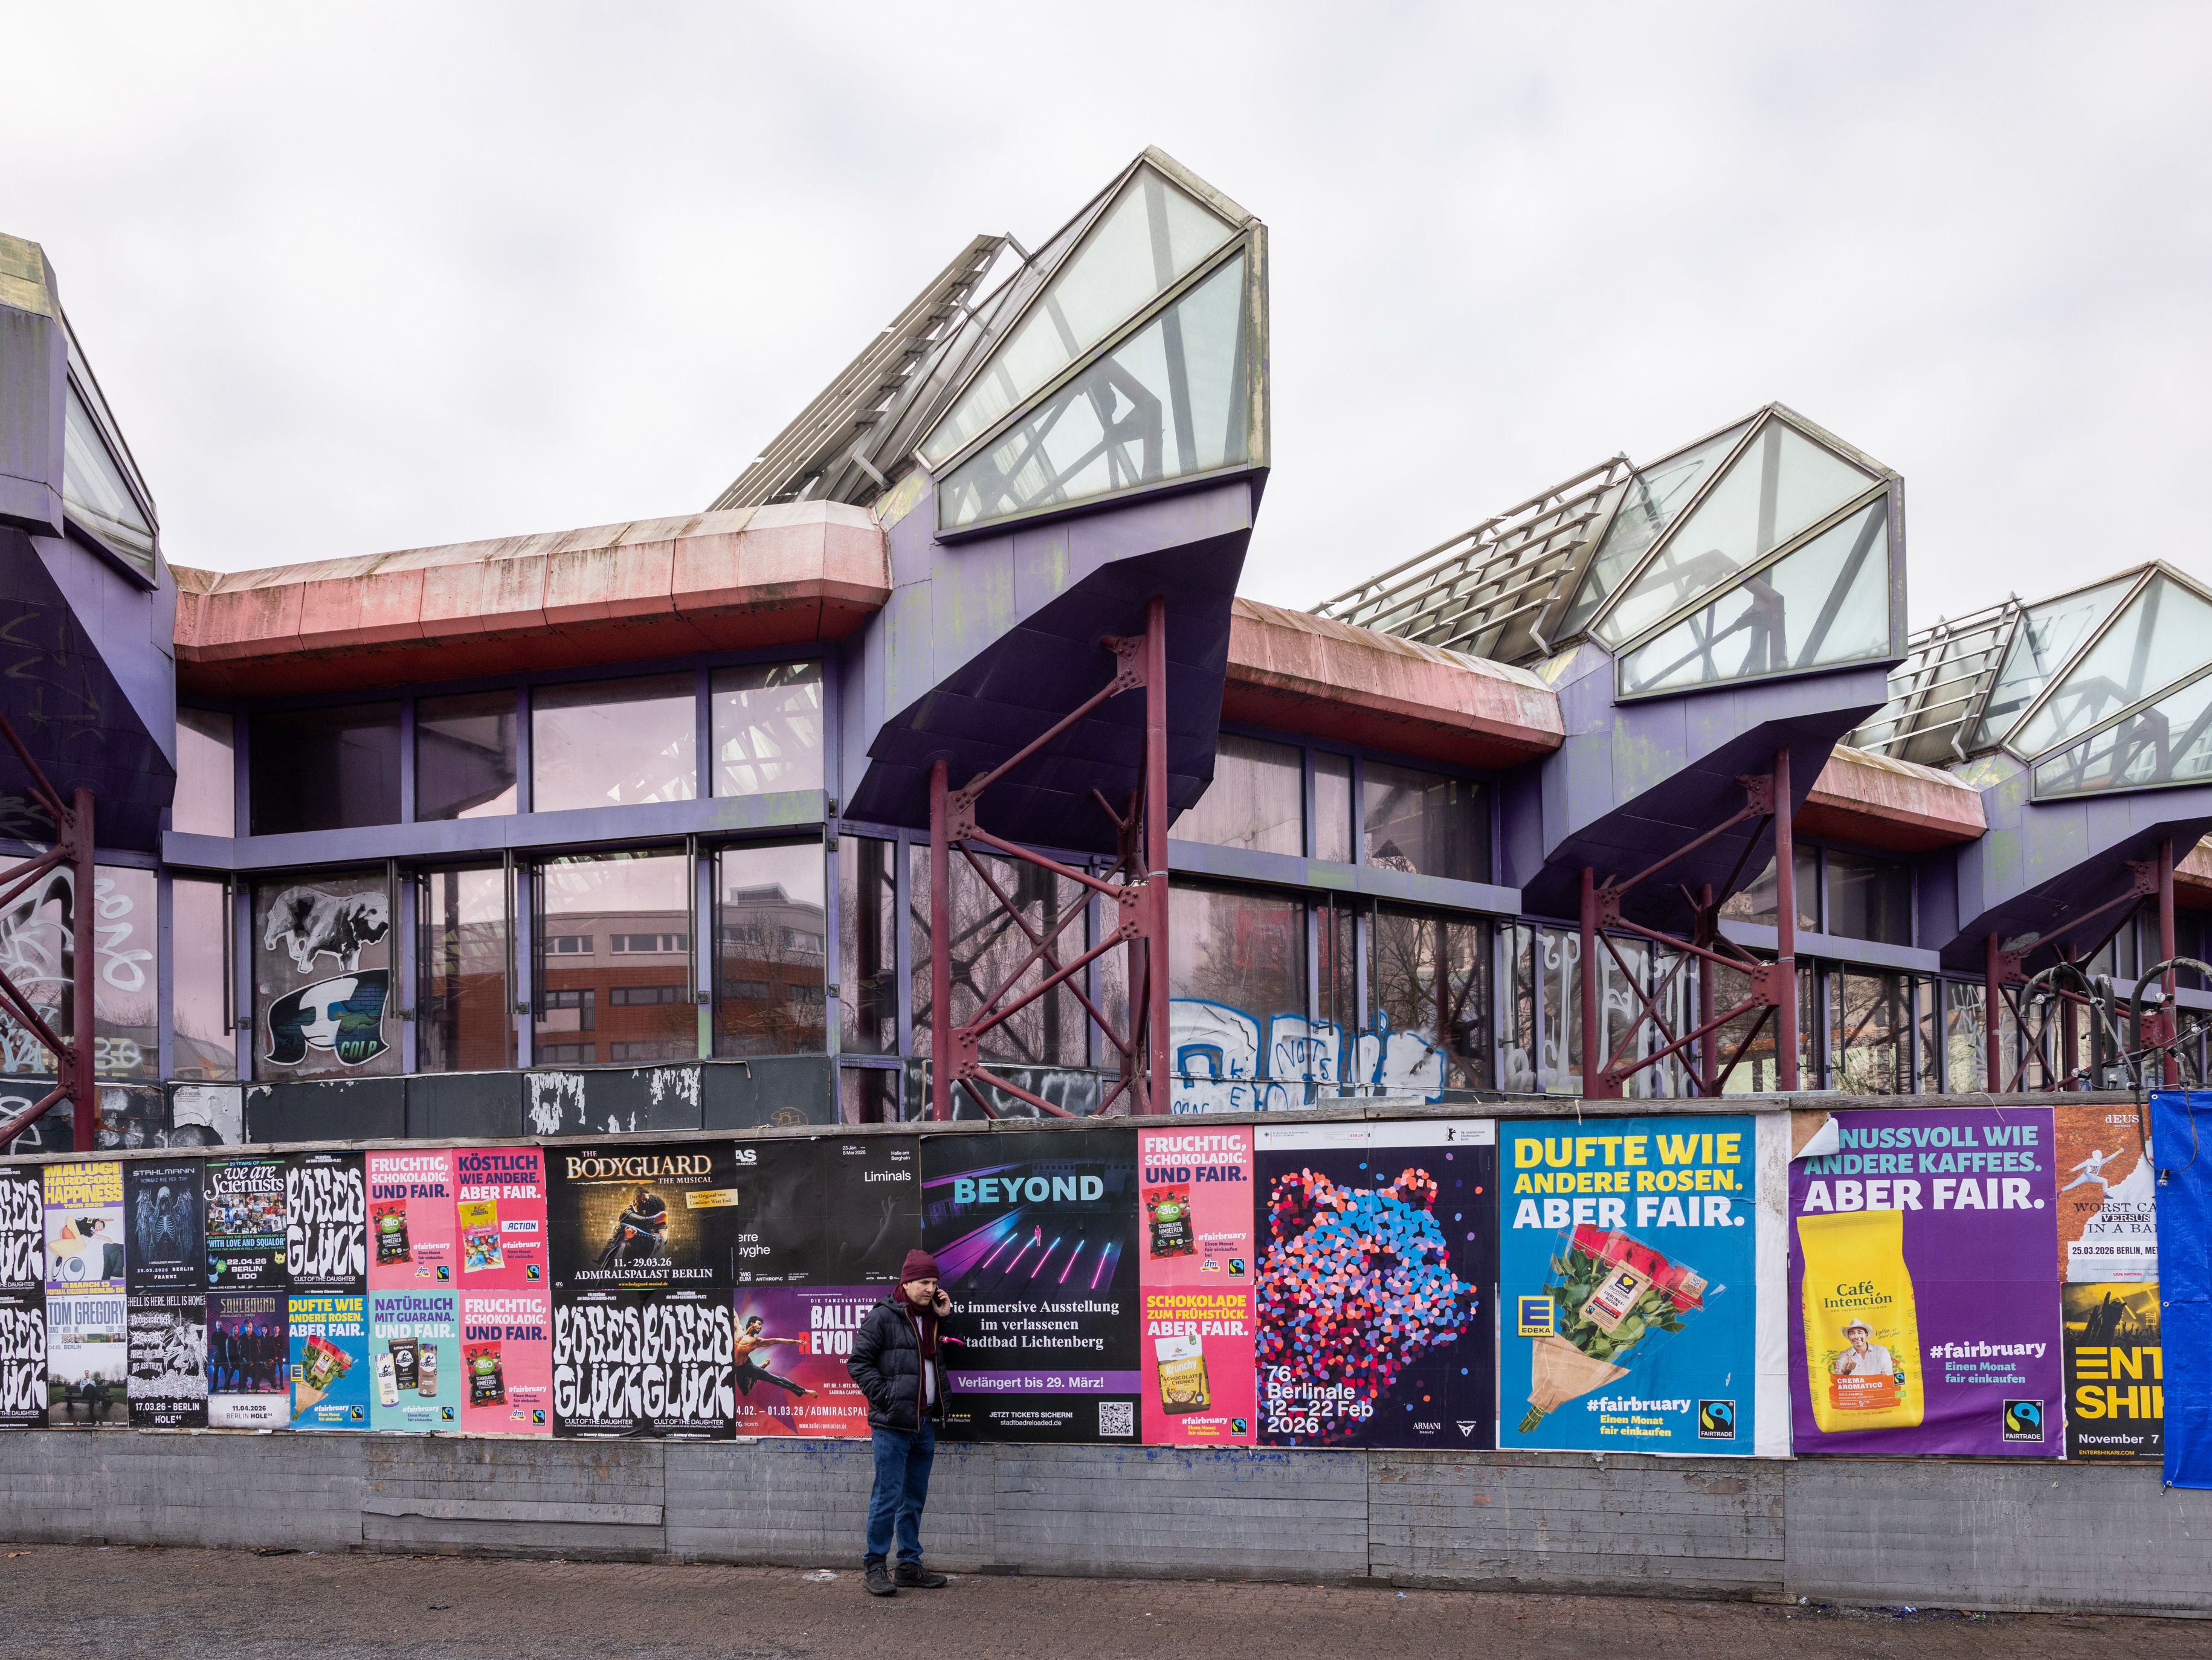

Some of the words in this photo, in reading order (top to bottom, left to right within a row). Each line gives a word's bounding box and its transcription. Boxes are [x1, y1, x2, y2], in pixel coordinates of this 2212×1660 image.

[2105, 1115, 2139, 1124] dEUS
[1145, 1135, 1246, 1153] FRUCHTIG,
[1839, 1126, 1979, 1149] NUSSVOLL
[1981, 1125, 2039, 1147] WIE
[1515, 1136, 1647, 1168] DUFTE
[1656, 1133, 1741, 1165] WIE
[372, 1157, 448, 1171] FRUCHTIG,
[459, 1153, 538, 1171] KÖSTLICH
[1145, 1153, 1246, 1165] SCHOKOLADIG.
[1804, 1153, 1914, 1174] ANDERE
[1918, 1151, 2042, 1173] KAFFEES.
[225, 1167, 248, 1180] we
[250, 1166, 276, 1179] are
[566, 1156, 712, 1179] BODYGUARD
[1146, 1167, 1191, 1183] UND
[1196, 1166, 1247, 1182] FAIR.
[45, 1174, 122, 1186] HARDCORE
[372, 1172, 449, 1183] SCHOKOLADIG.
[459, 1173, 483, 1185] WIE
[485, 1172, 540, 1184] ANDERE.
[865, 1170, 911, 1182] Liminals
[1514, 1171, 1630, 1194] ANDERE
[1637, 1170, 1743, 1192] ROSEN.
[45, 1183, 123, 1204] HAPPINESS
[204, 1174, 284, 1200] Scientists
[460, 1186, 500, 1200] ABER
[503, 1185, 541, 1198] FAIR.
[954, 1175, 1103, 1204] BEYOND
[1802, 1180, 1923, 1211] ABER
[1932, 1178, 2045, 1210] FAIR.
[1513, 1197, 1627, 1229] ABER
[1637, 1196, 1745, 1228] FAIR.
[2074, 1203, 2131, 1212] WORST
[2088, 1224, 2104, 1233] IN
[2113, 1224, 2123, 1233] A
[287, 1223, 365, 1278] GLÜCK
[2117, 1247, 2143, 1255] BERLIN,
[614, 1258, 626, 1267] 11.
[633, 1257, 672, 1267] 29.03.26
[575, 1269, 669, 1279] ADMIRALSPALAST
[672, 1269, 712, 1278] BERLIN
[1837, 1281, 1874, 1296] Café
[129, 1297, 143, 1306] HELL
[144, 1297, 149, 1306] IS
[151, 1296, 166, 1306] HERE,
[167, 1296, 181, 1305] HELL
[182, 1296, 187, 1305] IS
[189, 1296, 203, 1305] HOME
[375, 1296, 453, 1311] NATÜRLICH
[968, 1301, 1037, 1313] immersive
[1040, 1301, 1120, 1314] Ausstellung
[1147, 1295, 1246, 1308] SCHOKOLADE
[1824, 1293, 1893, 1308] Intención
[48, 1302, 71, 1325] TOM
[75, 1301, 125, 1325] GREGORY
[375, 1313, 396, 1322] MIT
[397, 1312, 454, 1322] GUARANA.
[1147, 1310, 1173, 1319] ZUM
[1176, 1308, 1248, 1319] FRÜHSTÜCK.
[375, 1324, 411, 1339] UND
[414, 1324, 455, 1338] FAIR.
[981, 1319, 998, 1330] im
[1002, 1318, 1079, 1330] verlassenen
[1147, 1321, 1197, 1336] ABER
[1202, 1321, 1249, 1336] FAIR.
[1021, 1336, 1104, 1350] Lichtenberg
[1930, 1341, 2046, 1360] #fairbruary
[1166, 1360, 1197, 1375] Krunchy
[1268, 1365, 1296, 1382] 76.
[958, 1377, 1021, 1389] Verlängert
[1025, 1377, 1043, 1388] bis
[1046, 1377, 1065, 1388] 29.
[1069, 1377, 1104, 1388] März!
[554, 1363, 642, 1420] GLÜCK
[1268, 1383, 1355, 1399] Berlinale
[1338, 1401, 1373, 1417] Feb
[1587, 1397, 1691, 1413] #fairbruary
[1268, 1417, 1319, 1433] 2026
[1601, 1415, 1628, 1424] Einen
[1631, 1415, 1663, 1425] Monat
[1600, 1426, 1619, 1435] fair
[1621, 1426, 1671, 1436] einkaufen
[2079, 1434, 2144, 1444] November
[2152, 1435, 2159, 1443] 7
